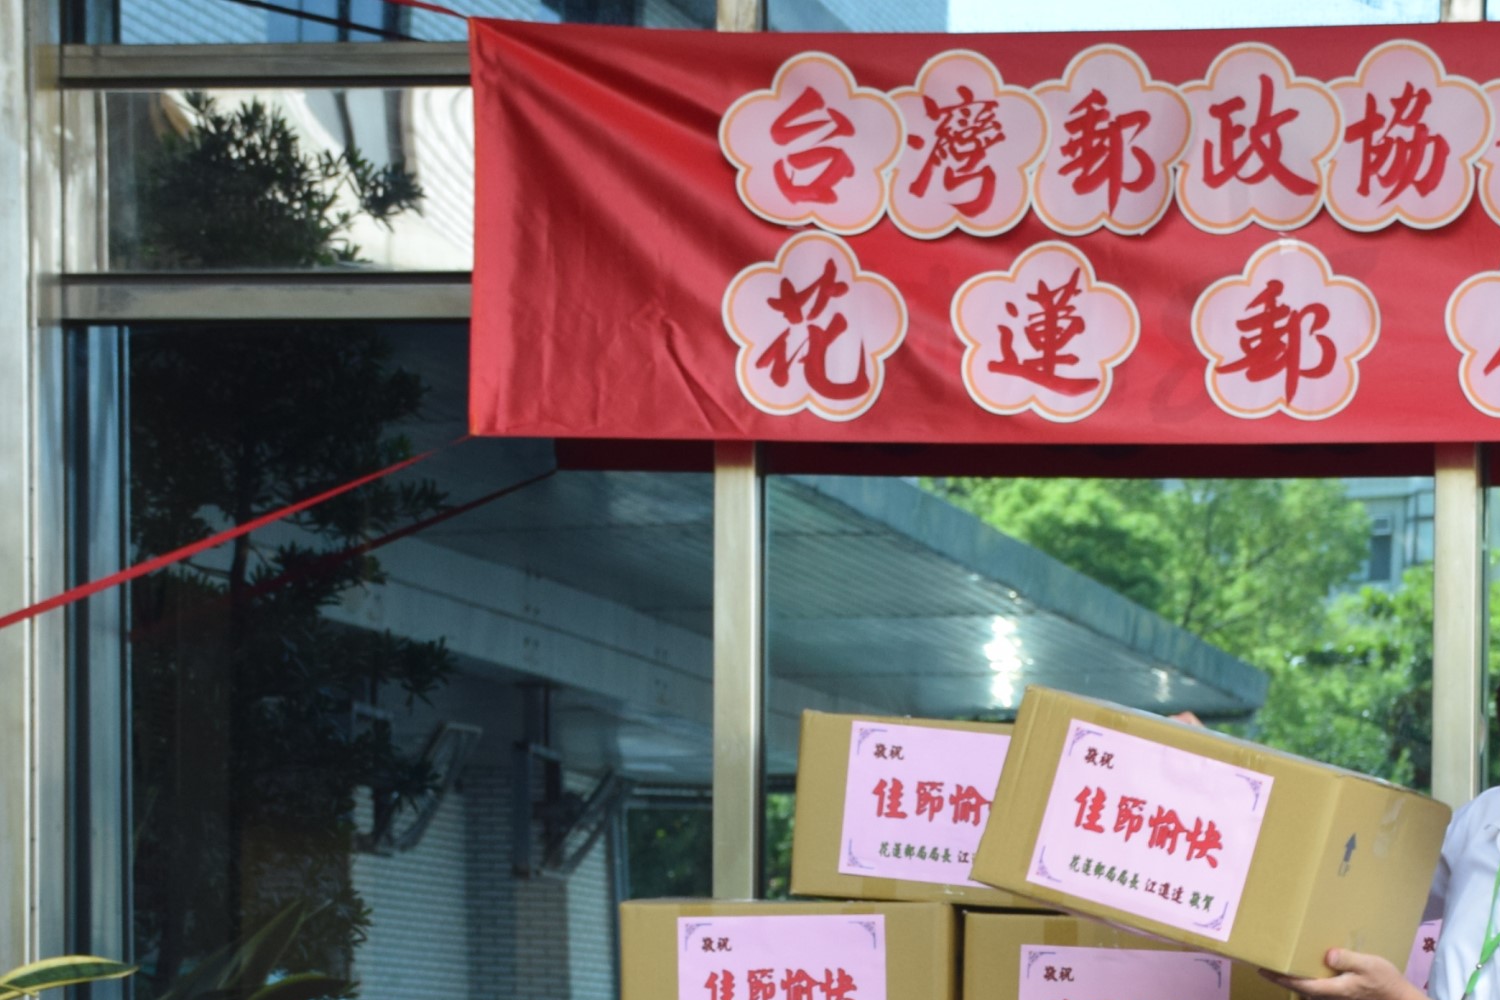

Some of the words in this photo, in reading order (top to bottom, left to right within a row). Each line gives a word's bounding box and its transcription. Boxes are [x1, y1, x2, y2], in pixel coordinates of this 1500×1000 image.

[872, 777, 992, 827] 佳節愉
[1074, 786, 1223, 869] 佳節愉快
